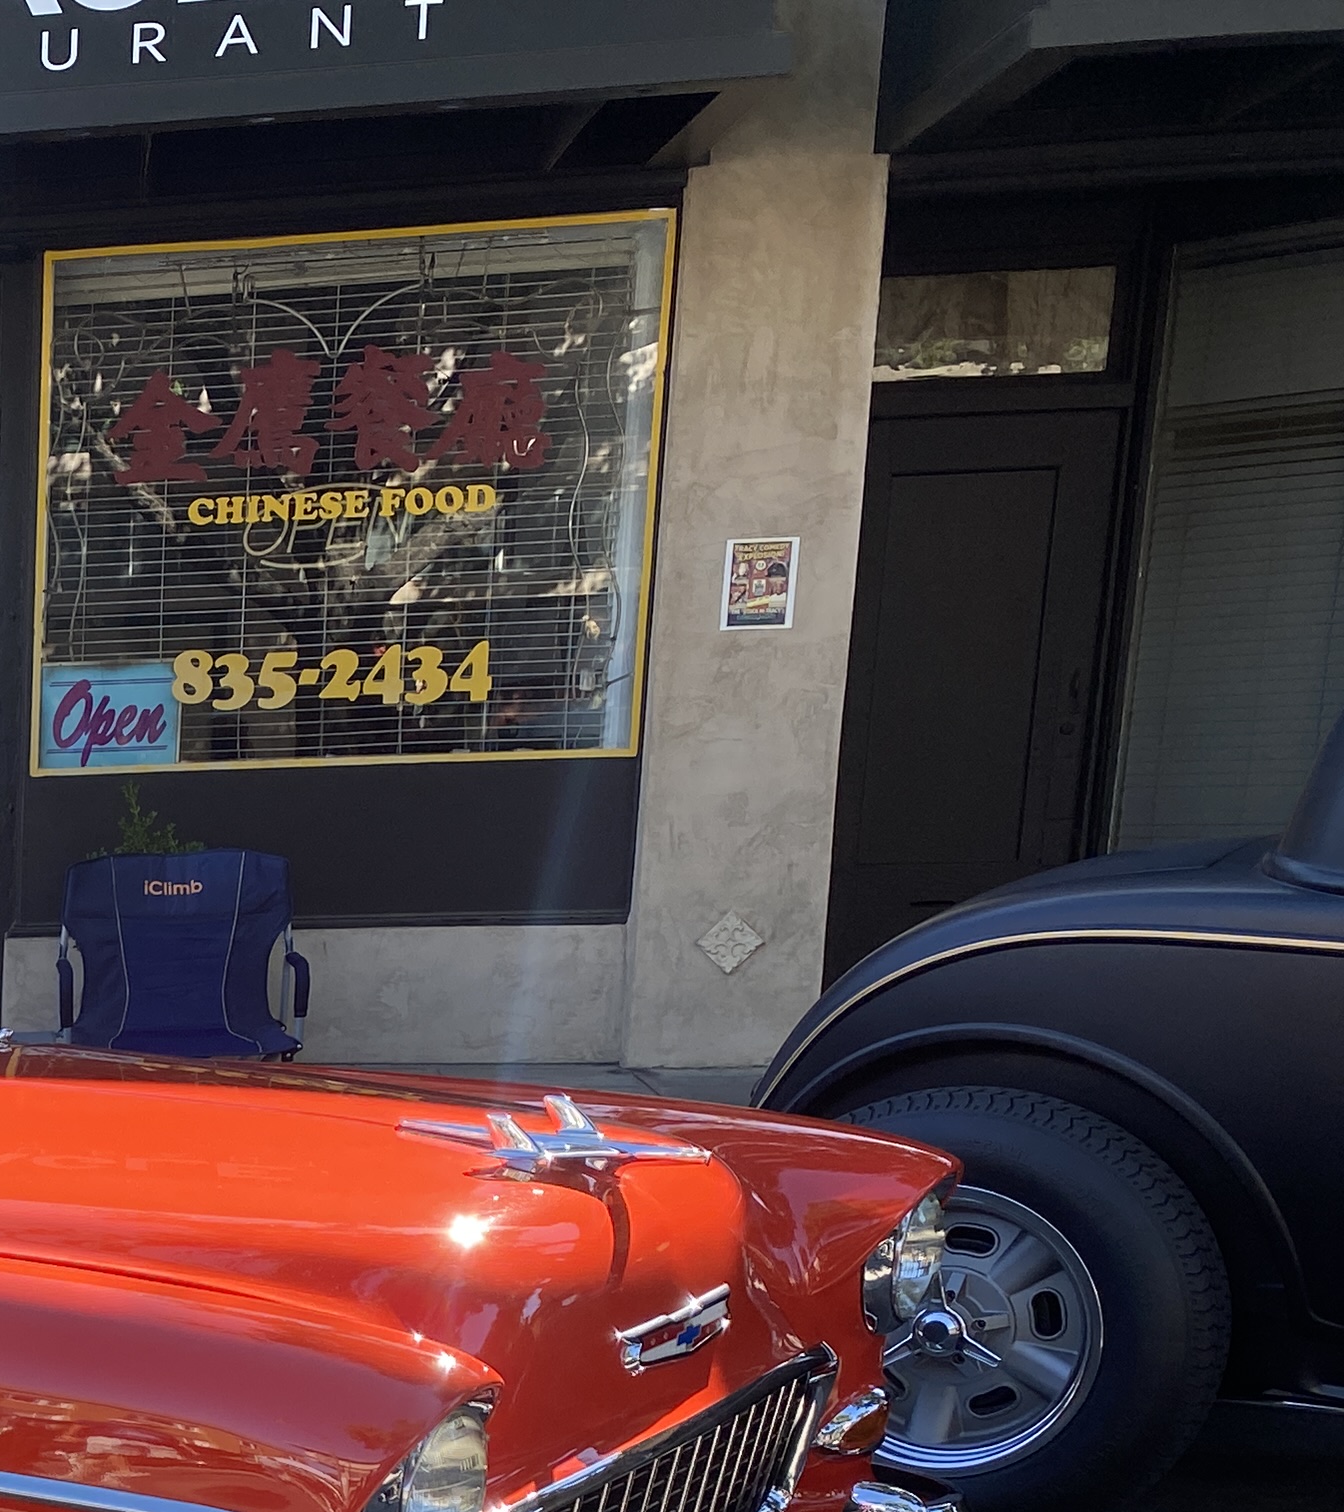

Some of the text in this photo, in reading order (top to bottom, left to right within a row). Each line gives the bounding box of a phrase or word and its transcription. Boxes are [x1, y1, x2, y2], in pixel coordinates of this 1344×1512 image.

[187, 484, 496, 526] CHINESE FOOD
[171, 640, 493, 711] 835-2434
[52, 679, 167, 768] Open
[143, 878, 204, 897] iClimb
